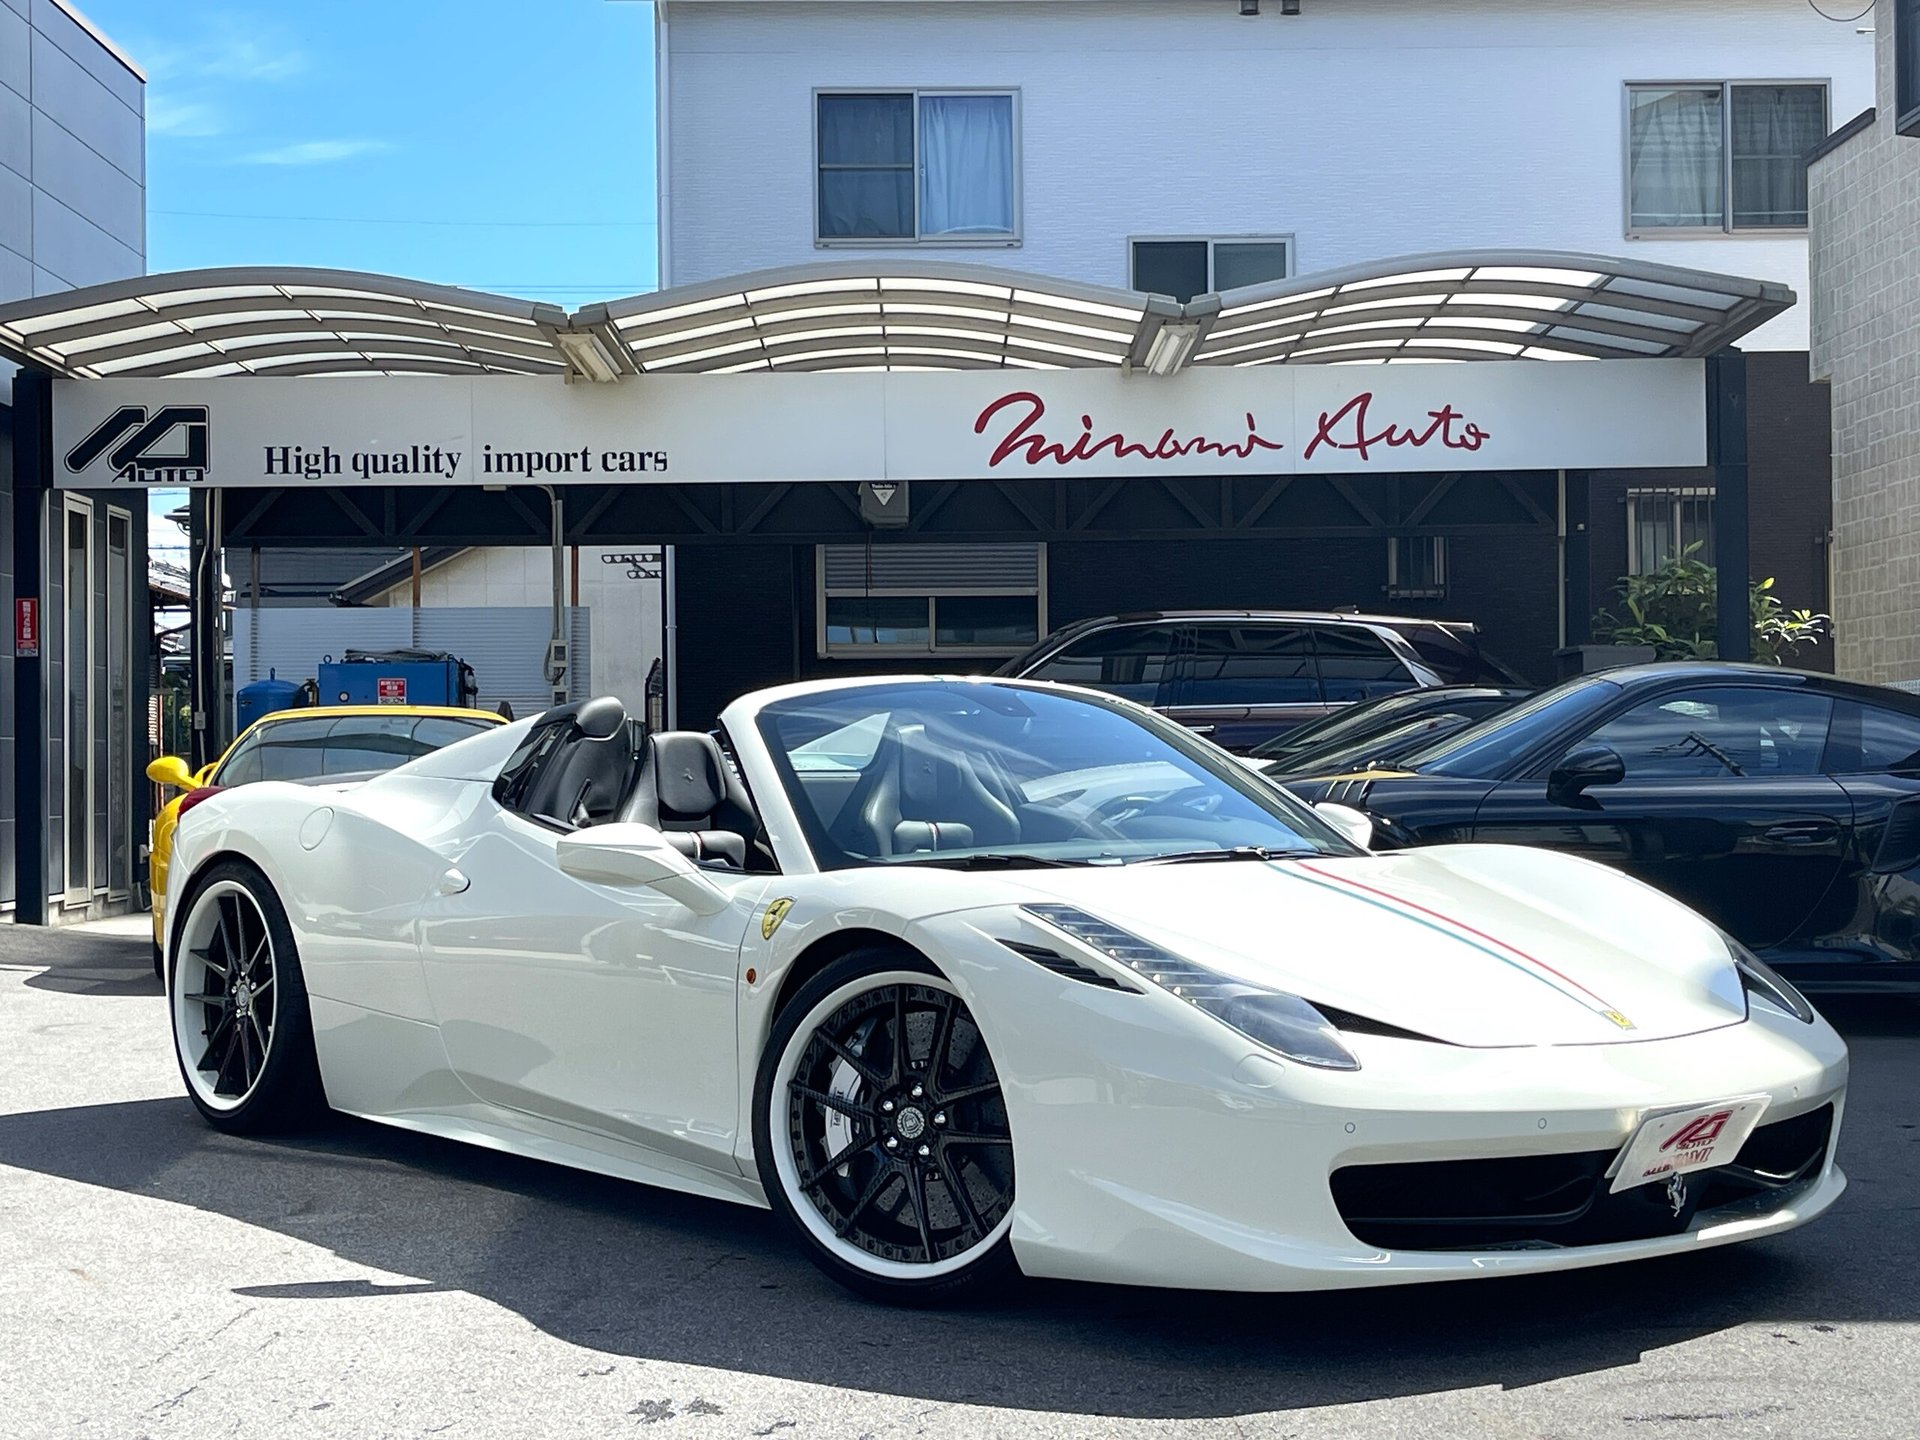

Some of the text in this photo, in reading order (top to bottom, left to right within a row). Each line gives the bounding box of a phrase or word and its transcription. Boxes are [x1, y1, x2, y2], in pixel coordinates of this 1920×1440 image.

[974, 391, 1491, 467] Minami Auto
[112, 462, 205, 483] AUTO
[263, 444, 668, 480] High quality import cars
